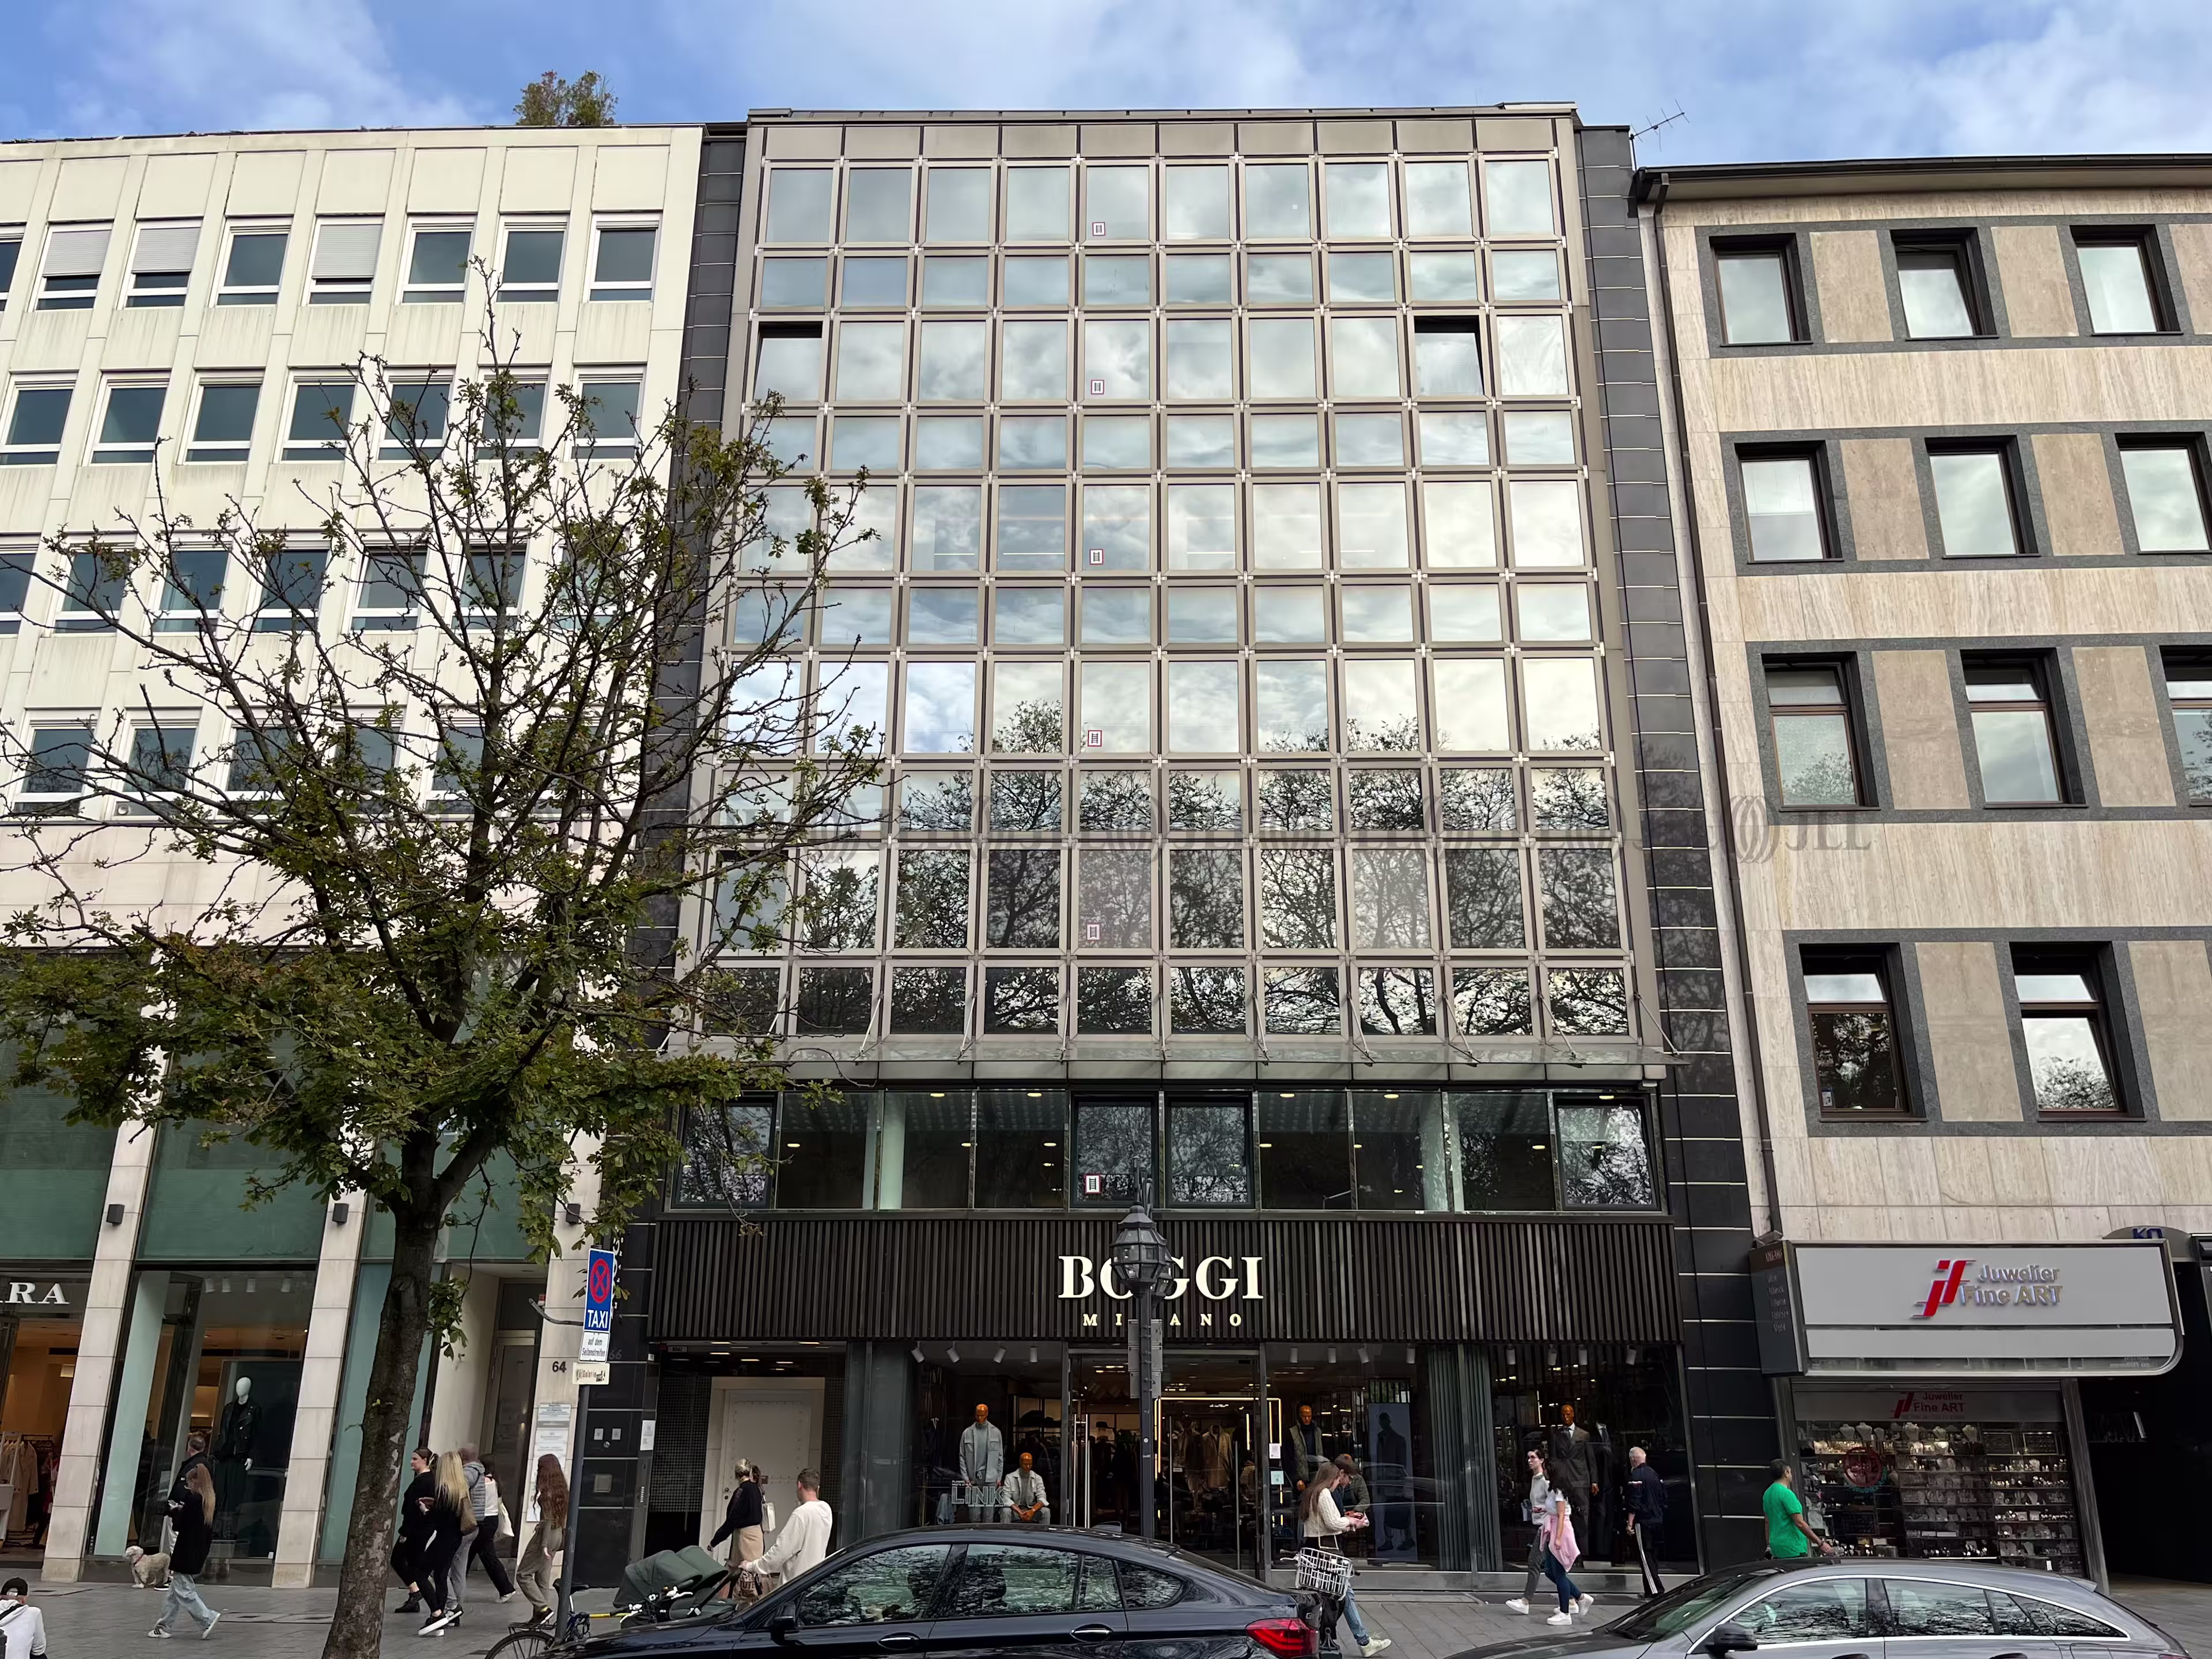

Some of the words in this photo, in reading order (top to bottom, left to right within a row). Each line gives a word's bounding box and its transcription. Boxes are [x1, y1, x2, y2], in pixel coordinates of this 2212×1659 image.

[1978, 1265, 2060, 1283] Juwelier
[0, 1283, 70, 1304] RA
[1960, 1285, 2010, 1305] Fine
[2014, 1285, 2063, 1305] ART
[588, 1309, 608, 1328] TAXI
[1083, 1314, 1241, 1326] MIANO
[594, 1337, 603, 1346] dem
[582, 1347, 605, 1357] Seitenstreifen
[609, 1349, 622, 1360] 66
[552, 1361, 566, 1373] 64
[1922, 1392, 1963, 1400] Juwelier
[1914, 1402, 1938, 1412] Fine
[1941, 1403, 1966, 1412] ART
[951, 1486, 1006, 1504] LINK
